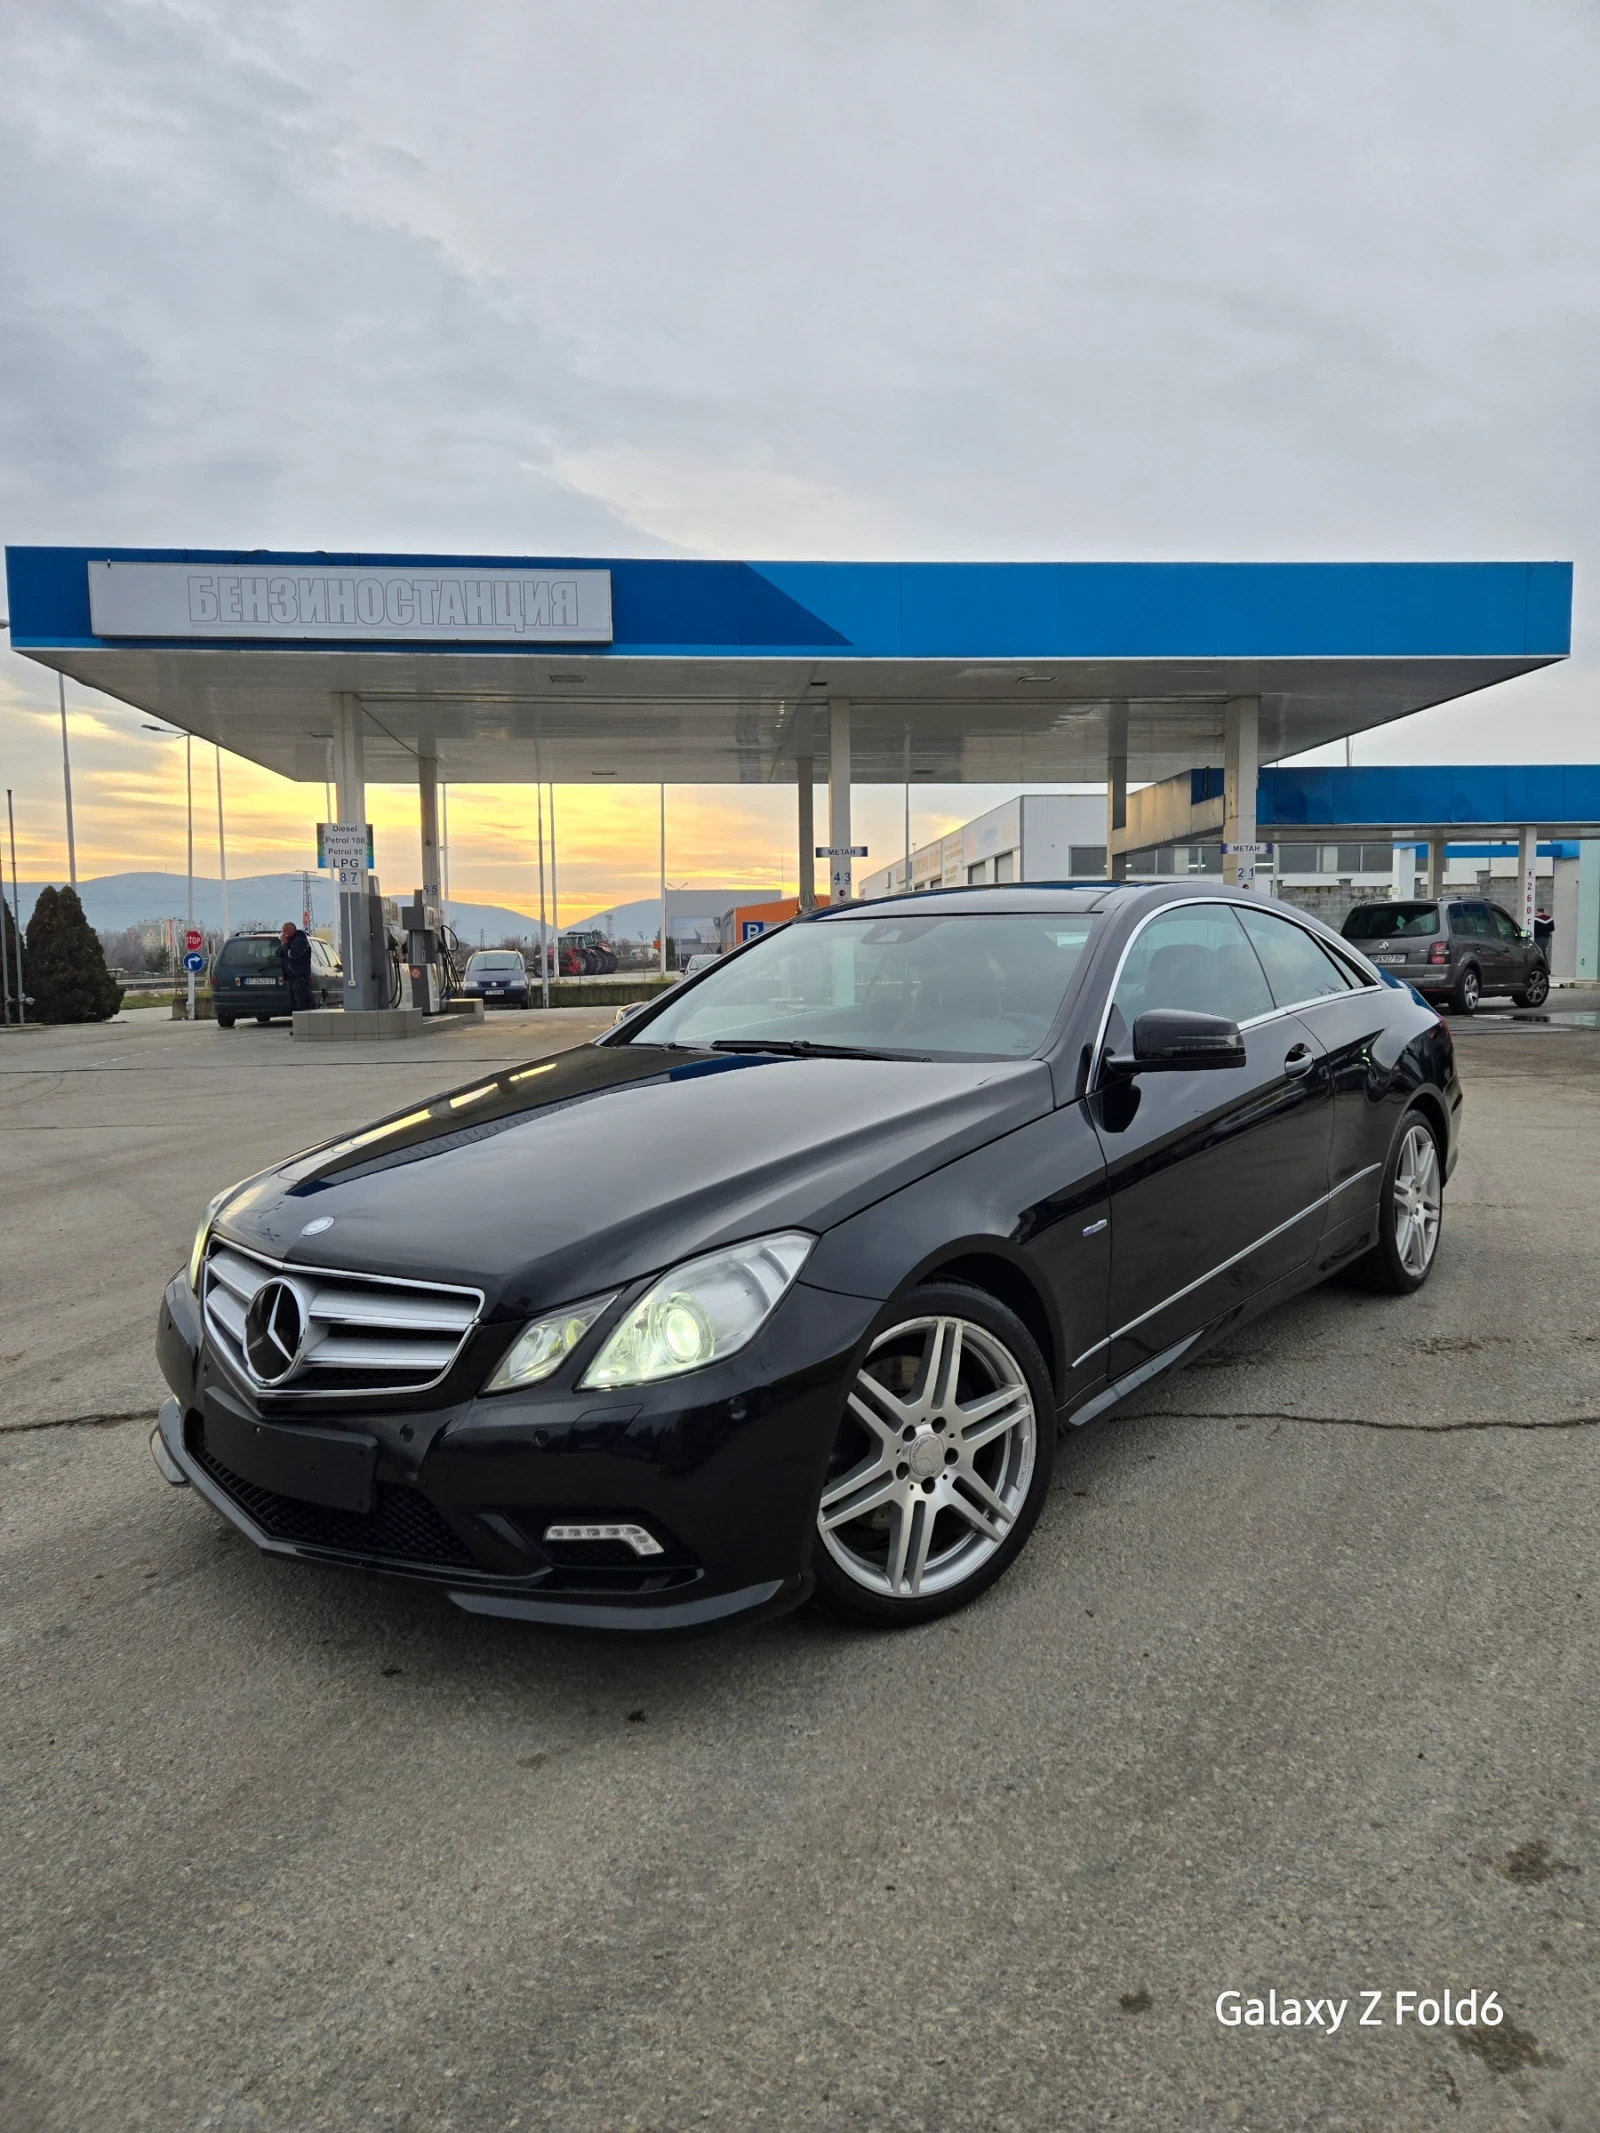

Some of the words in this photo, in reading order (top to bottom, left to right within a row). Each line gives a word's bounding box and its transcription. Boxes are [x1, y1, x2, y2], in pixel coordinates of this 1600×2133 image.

[187, 576, 578, 633] БЕНЗИНОСТАНЦИЯ
[332, 825, 358, 833] Diesel
[332, 858, 359, 868] LPG
[340, 873, 347, 883] 8
[350, 872, 358, 882] 7
[833, 872, 841, 882] 4
[844, 872, 851, 882] 3
[1237, 867, 1245, 878] 2
[1249, 867, 1254, 878] 1
[431, 885, 438, 893] 5
[747, 924, 760, 940] P
[186, 936, 201, 945] STOP
